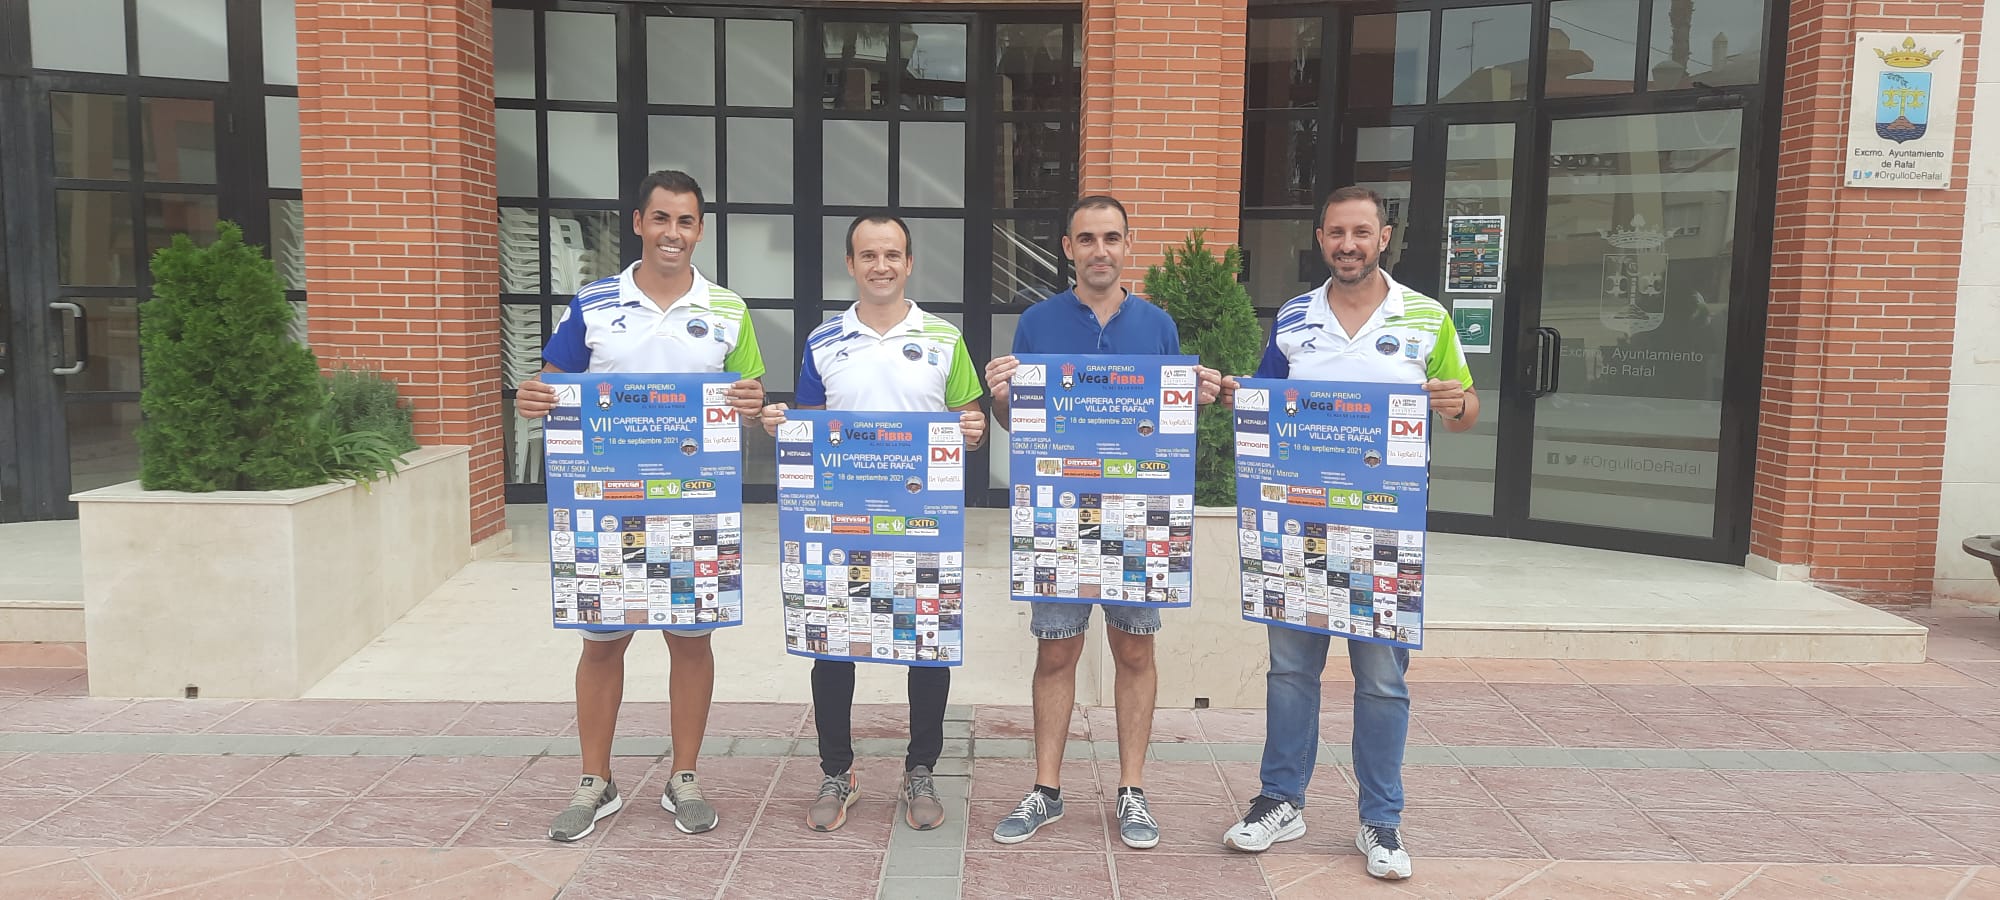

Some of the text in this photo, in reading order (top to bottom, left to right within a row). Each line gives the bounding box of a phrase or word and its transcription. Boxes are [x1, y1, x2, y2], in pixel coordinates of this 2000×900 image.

[1855, 148, 1944, 158] Excmo. Ayuntamiento
[1875, 171, 1942, 180] #OrgulloDeRafal
[1612, 348, 1704, 362] Ayuntamiento
[1601, 365, 1656, 377] de Rafal
[1053, 397, 1072, 411] VII
[1163, 391, 1192, 405] DM
[706, 408, 736, 423] DM
[589, 418, 611, 432] VII
[613, 416, 654, 424] CARRERA
[1276, 423, 1381, 437] VII CARRERA POPULAR
[1392, 420, 1422, 436] DM
[1348, 434, 1374, 443] RAFAL
[820, 453, 840, 467] VII
[931, 448, 960, 462] DM
[1583, 455, 1701, 475] #OrgulloDeRafal
